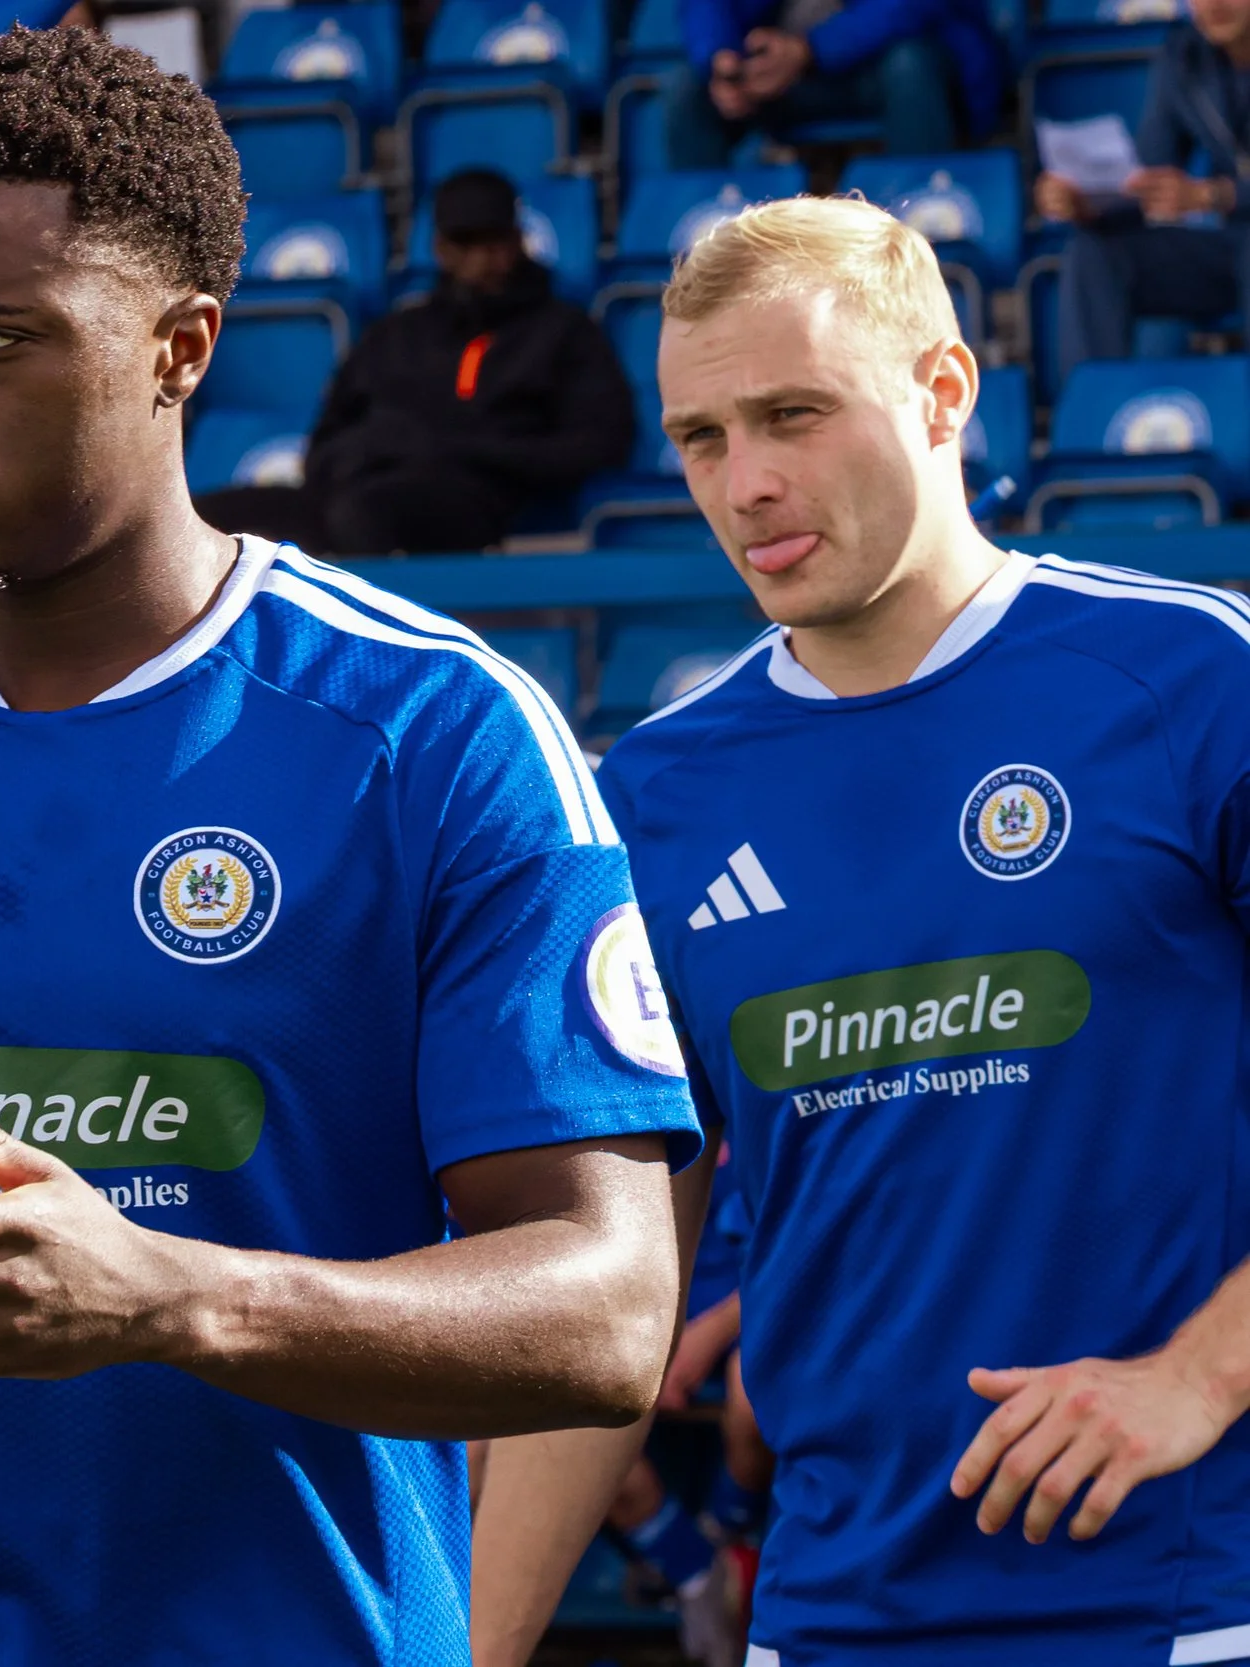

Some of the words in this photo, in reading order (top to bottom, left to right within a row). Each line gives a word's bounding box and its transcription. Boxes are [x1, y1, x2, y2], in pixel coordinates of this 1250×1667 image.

[969, 773, 1010, 818] CURZON
[1014, 771, 1061, 804] ASHTON
[148, 835, 206, 879] CURZON
[214, 835, 270, 880] ASHTON
[971, 843, 1032, 872] FOOTBALL
[1035, 830, 1061, 860] CLUB
[148, 911, 226, 952] FOOTBALL
[231, 910, 265, 945] CLUB
[783, 975, 1025, 1068] Pinnacle
[793, 1072, 910, 1118] Electrical
[914, 1058, 1030, 1096] Supplies
